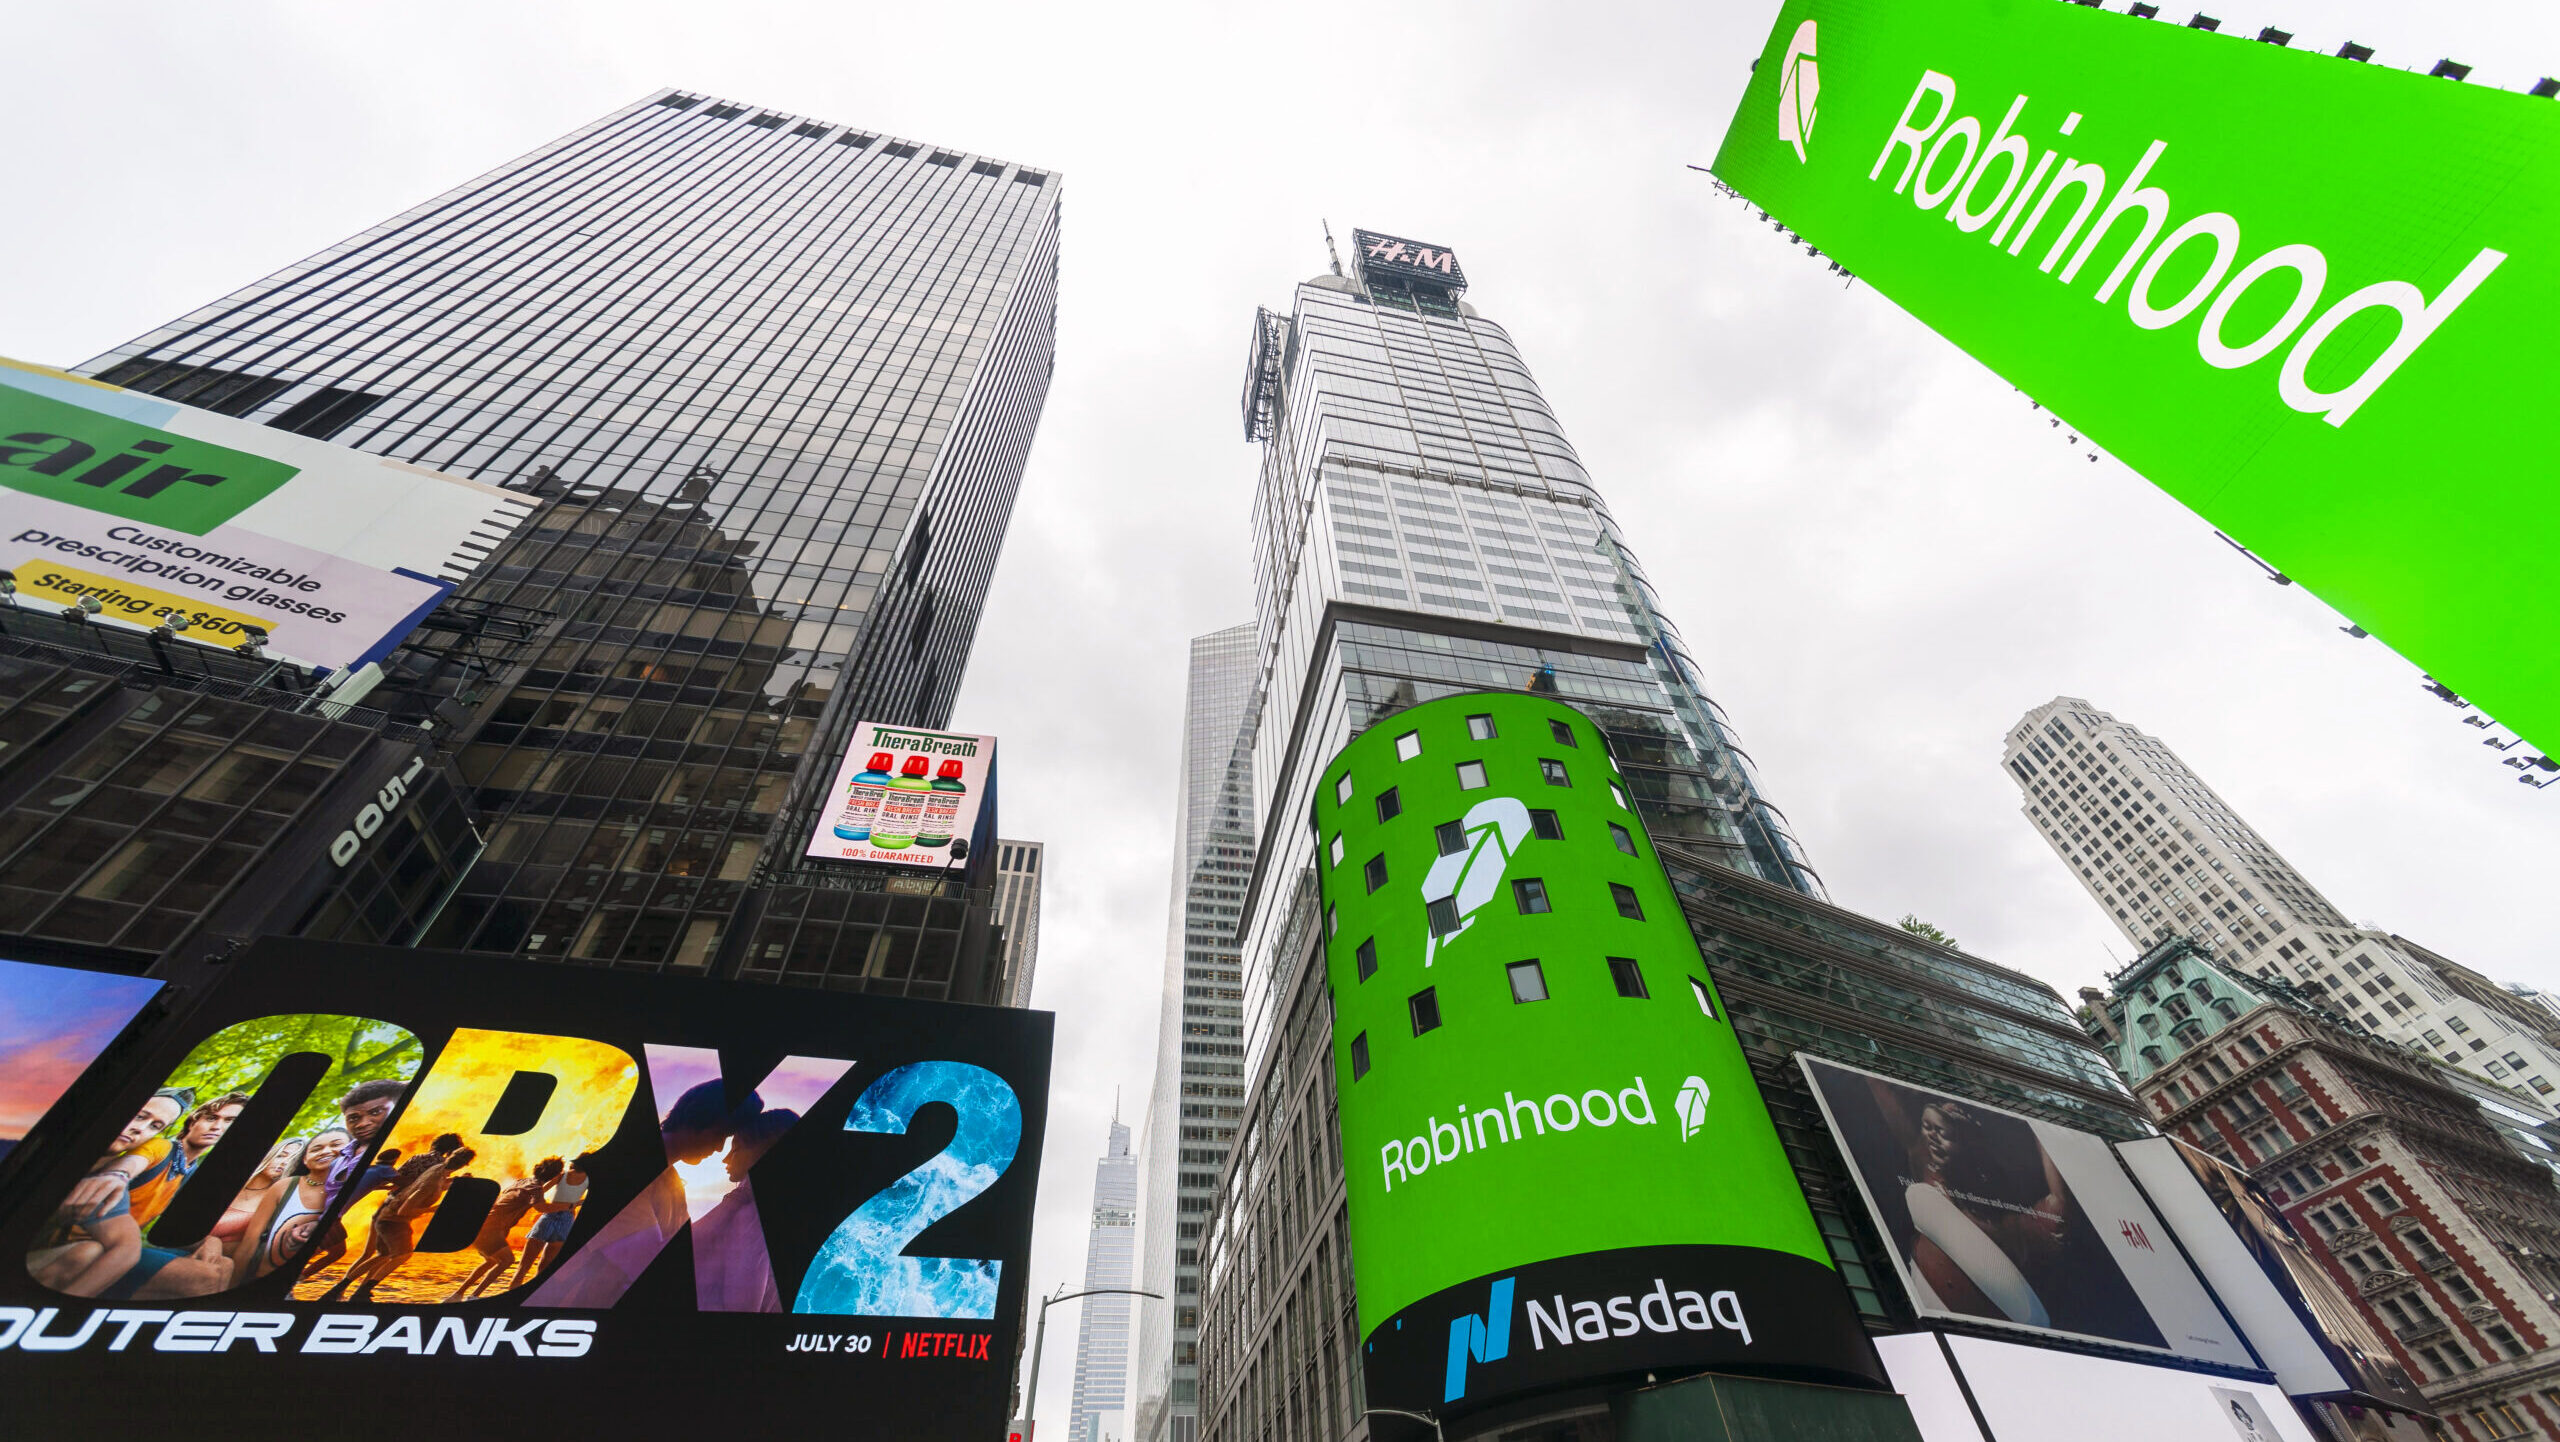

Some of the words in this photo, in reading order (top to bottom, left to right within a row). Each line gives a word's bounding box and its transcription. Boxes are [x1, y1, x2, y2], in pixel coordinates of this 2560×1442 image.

[1366, 239, 1453, 274] H&M
[1868, 69, 2508, 429] Robinhood
[11, 528, 226, 593] prescription
[223, 584, 347, 624] glasses
[106, 526, 322, 593] Customizable
[33, 573, 155, 614] Starting
[872, 727, 980, 758] TheraBreath
[330, 756, 425, 868] 1500
[842, 847, 867, 858] 100%
[870, 850, 934, 864] GUARANTEED
[1381, 1076, 1657, 1193] Robinhood
[26, 1013, 1022, 1320] OBX2
[2118, 1218, 2155, 1253] H&M
[1526, 1278, 1753, 1350] Nasdaq
[300, 1315, 597, 1357] BANKS
[786, 1334, 842, 1352] JULY
[844, 1335, 872, 1354] 30
[900, 1331, 992, 1361] NETFLIX
